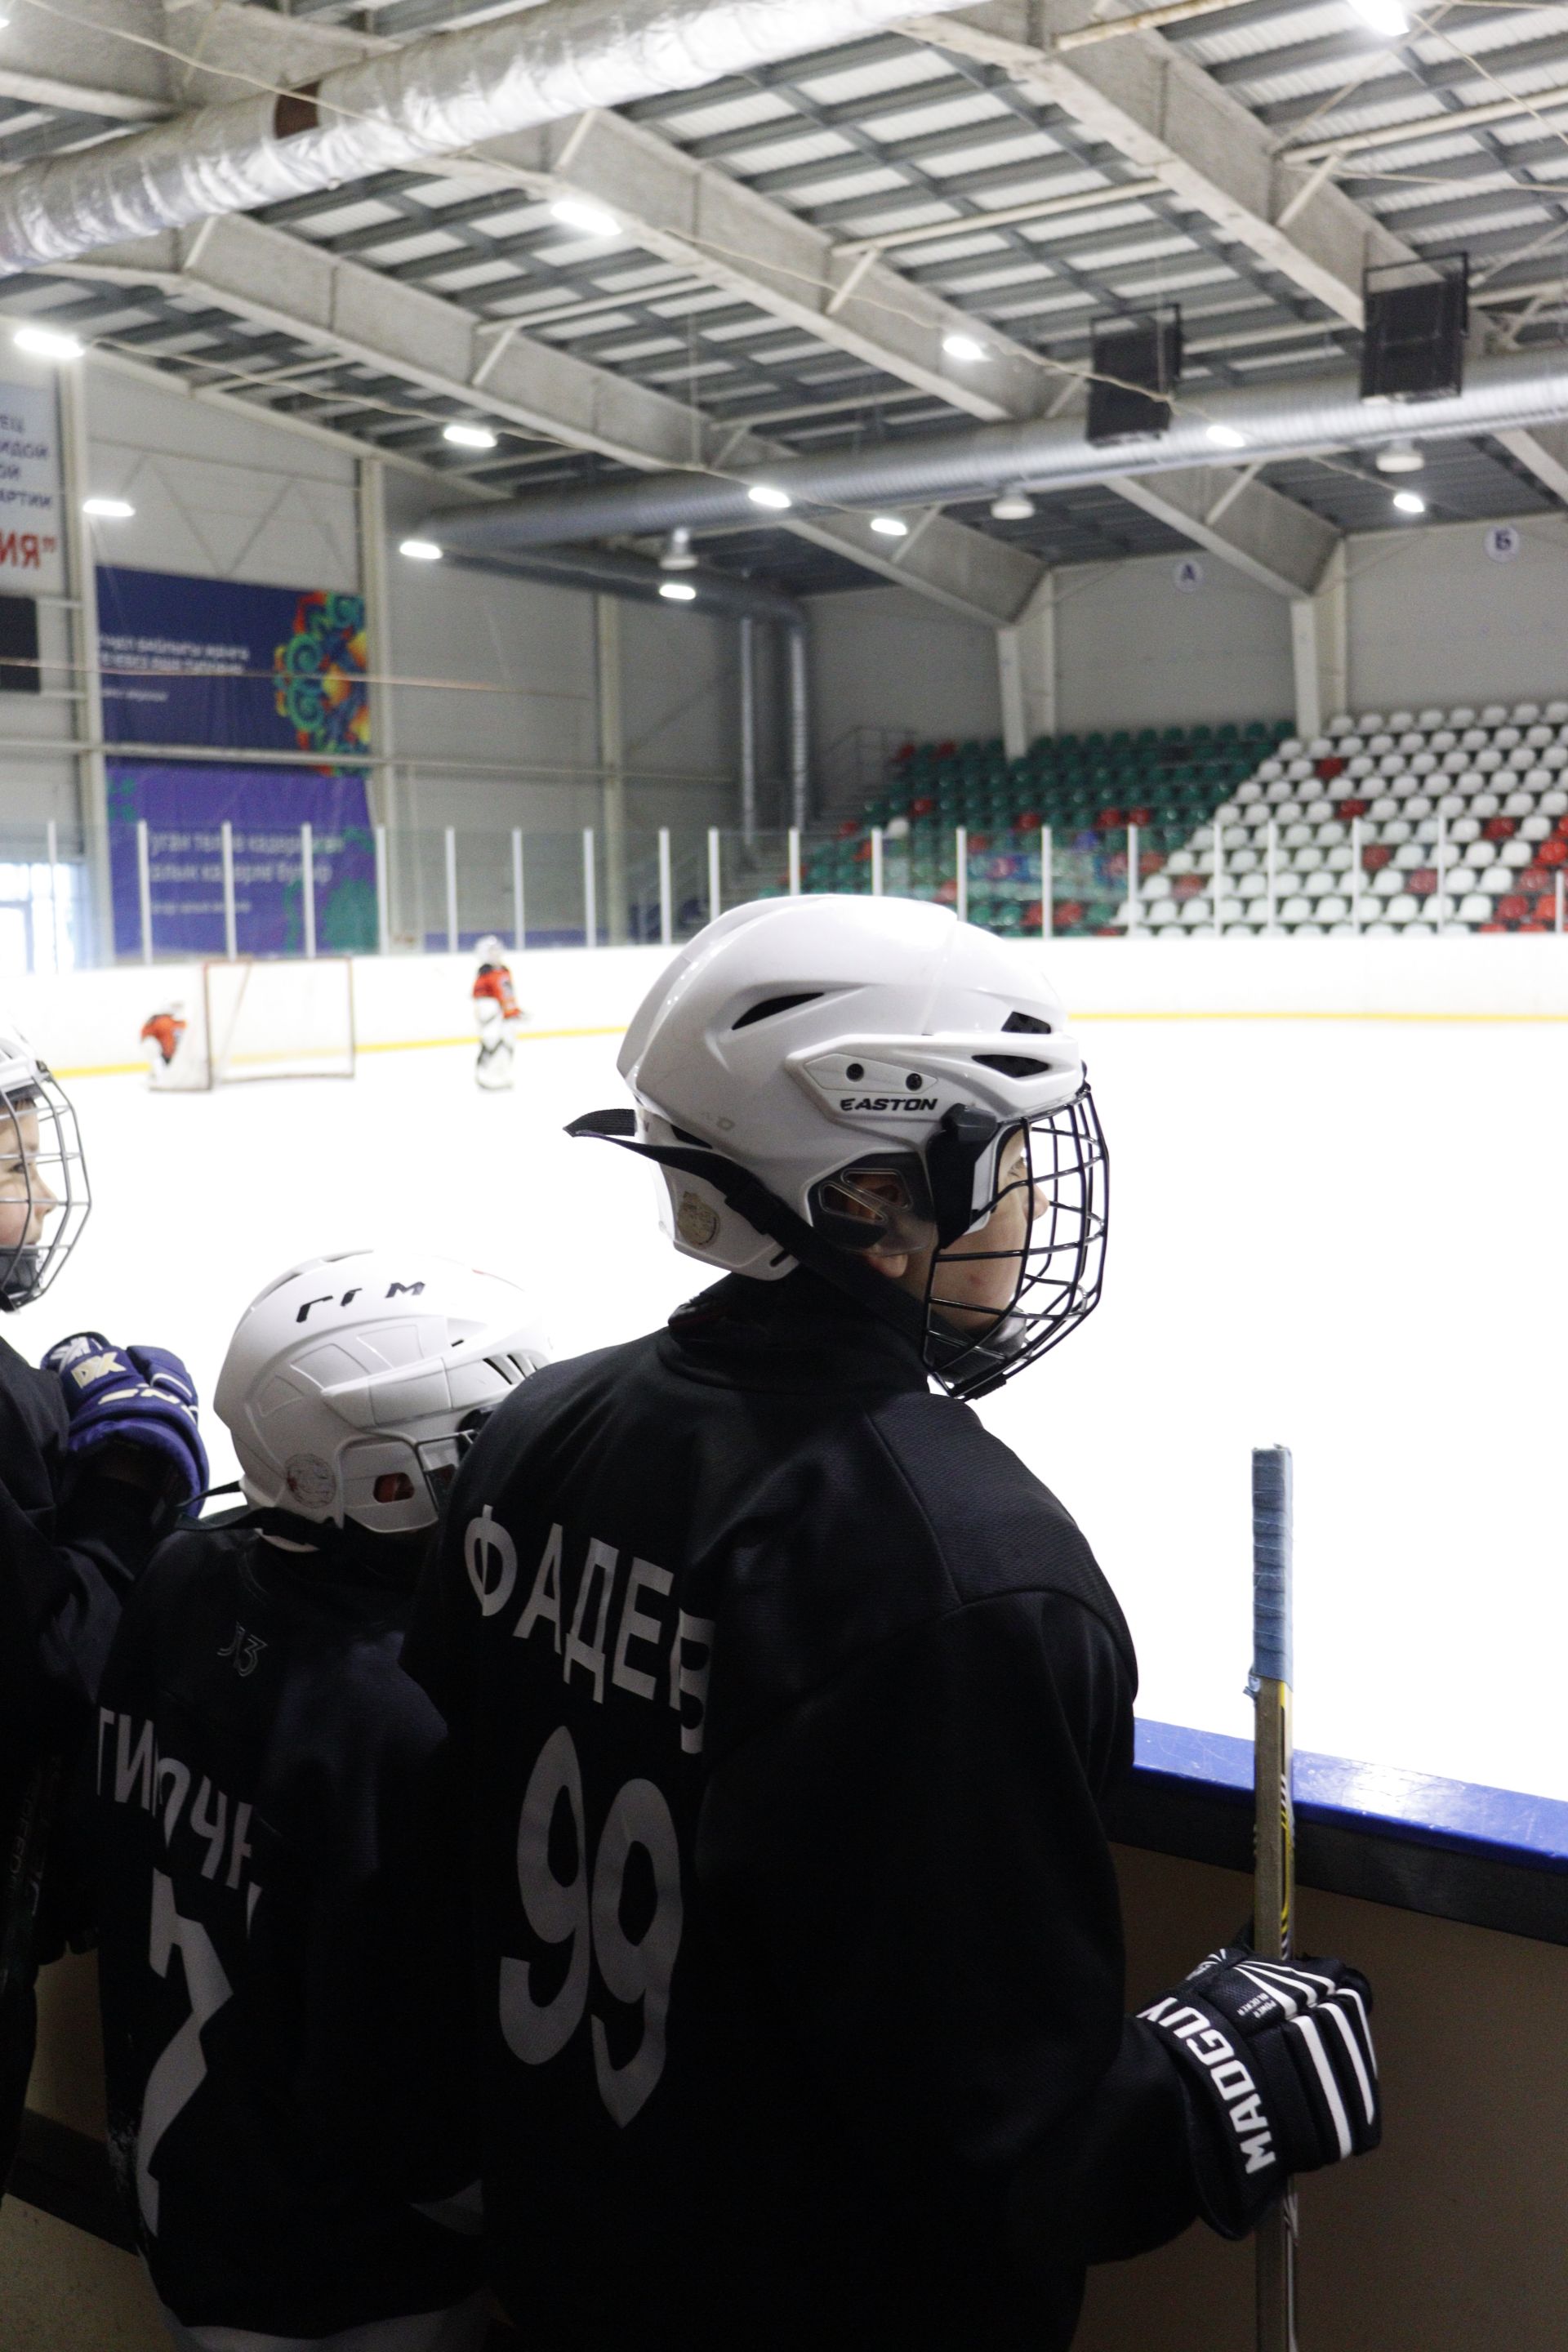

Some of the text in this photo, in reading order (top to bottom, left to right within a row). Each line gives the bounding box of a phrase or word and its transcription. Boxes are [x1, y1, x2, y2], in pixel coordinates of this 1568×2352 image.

[840, 1098, 938, 1111] EASTON
[498, 1725, 684, 2128] 99
[1135, 1997, 1276, 2174] MADGUY
